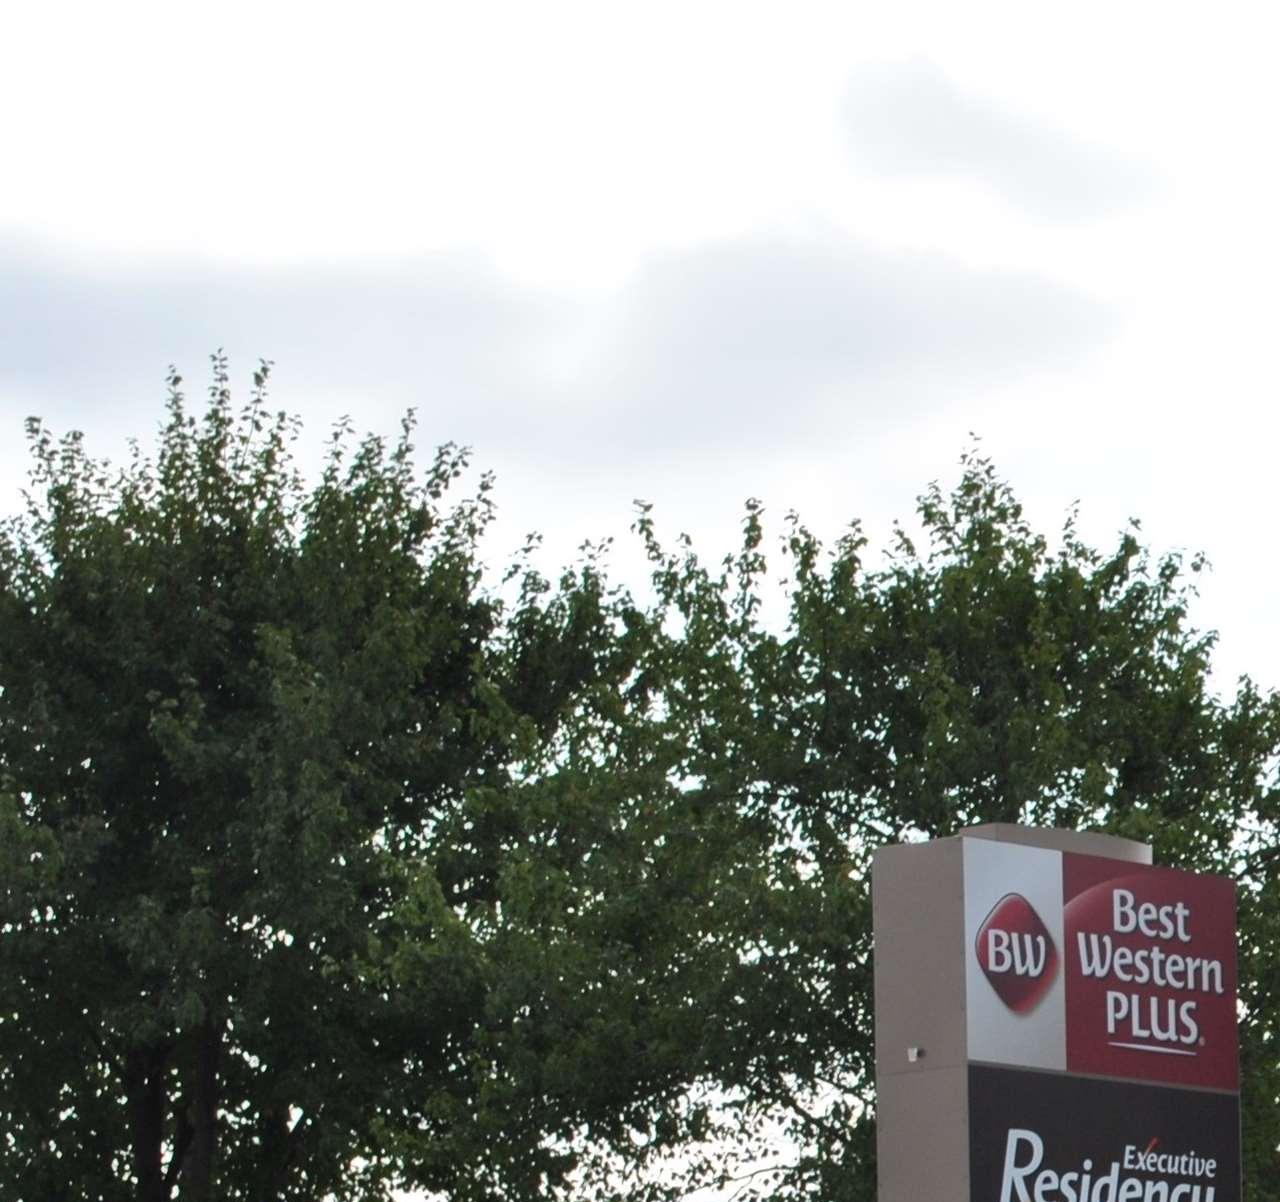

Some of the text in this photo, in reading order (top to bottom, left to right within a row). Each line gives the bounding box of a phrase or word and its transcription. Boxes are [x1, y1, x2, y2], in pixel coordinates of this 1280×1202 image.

[1113, 889, 1191, 943] Best
[988, 929, 1046, 978] BW
[1077, 932, 1225, 994] Western
[1106, 990, 1201, 1045] PLUS
[1122, 1143, 1217, 1178] Executive
